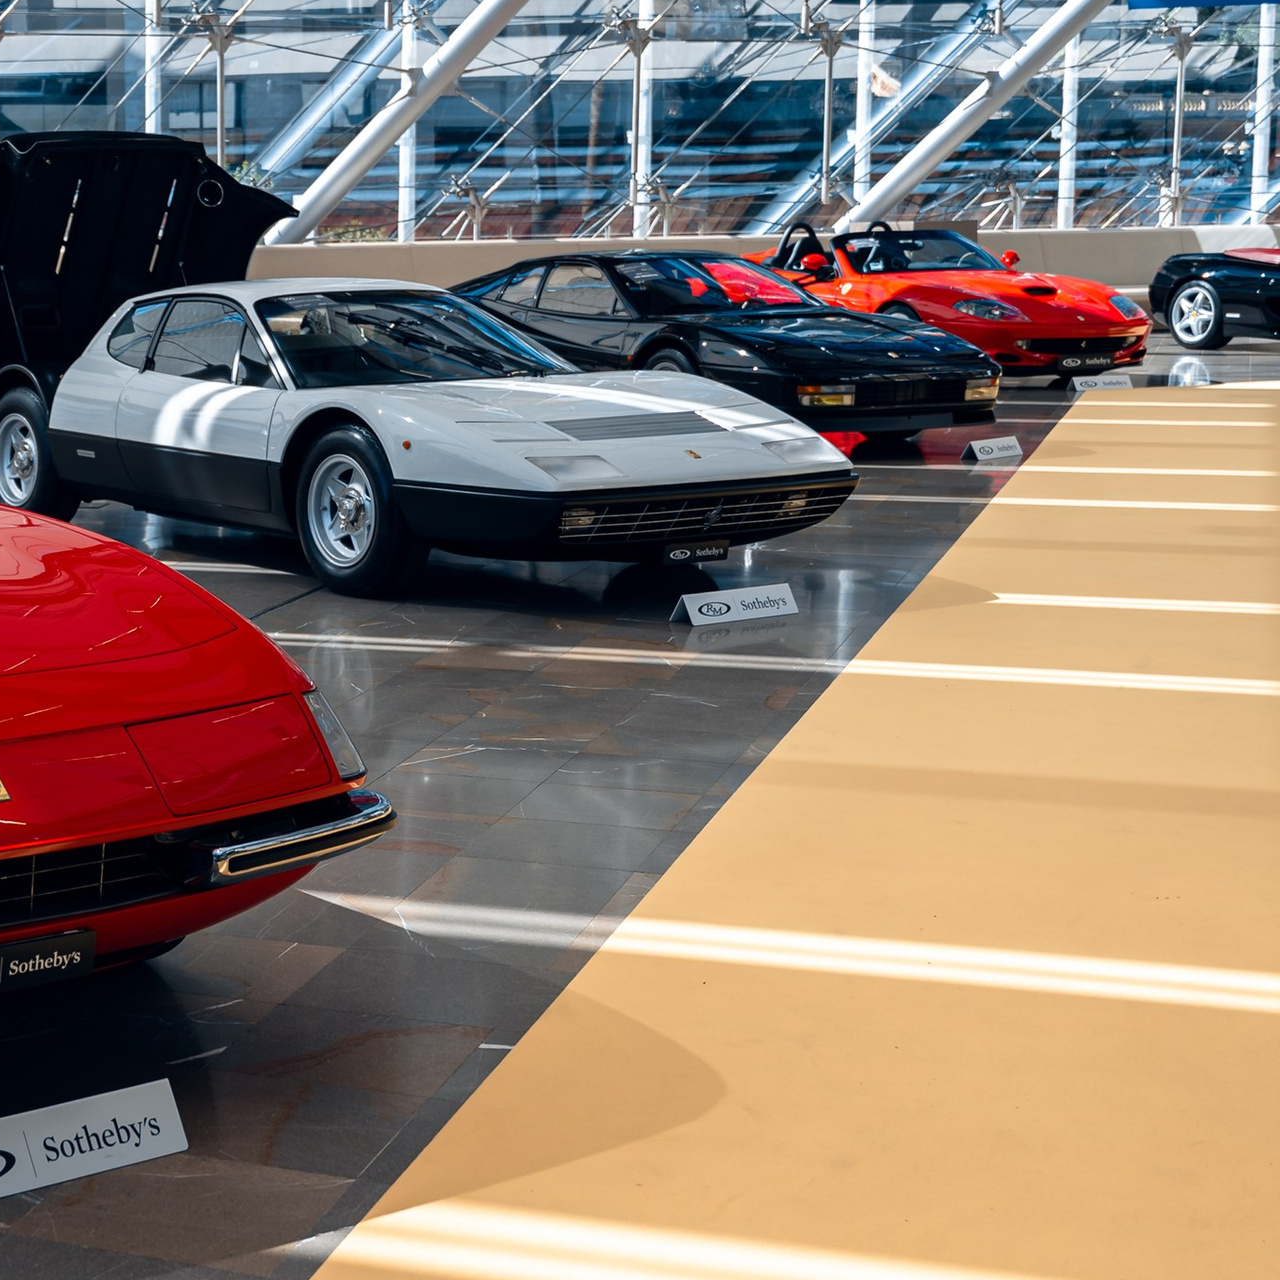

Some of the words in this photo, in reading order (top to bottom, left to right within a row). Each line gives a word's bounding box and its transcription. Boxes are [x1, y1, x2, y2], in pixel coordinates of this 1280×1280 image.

[695, 547, 724, 557] Sotheby's
[740, 596, 787, 612] Sotheby's
[8, 950, 81, 976] Sotheby's
[42, 1115, 161, 1163] Sotheby's
